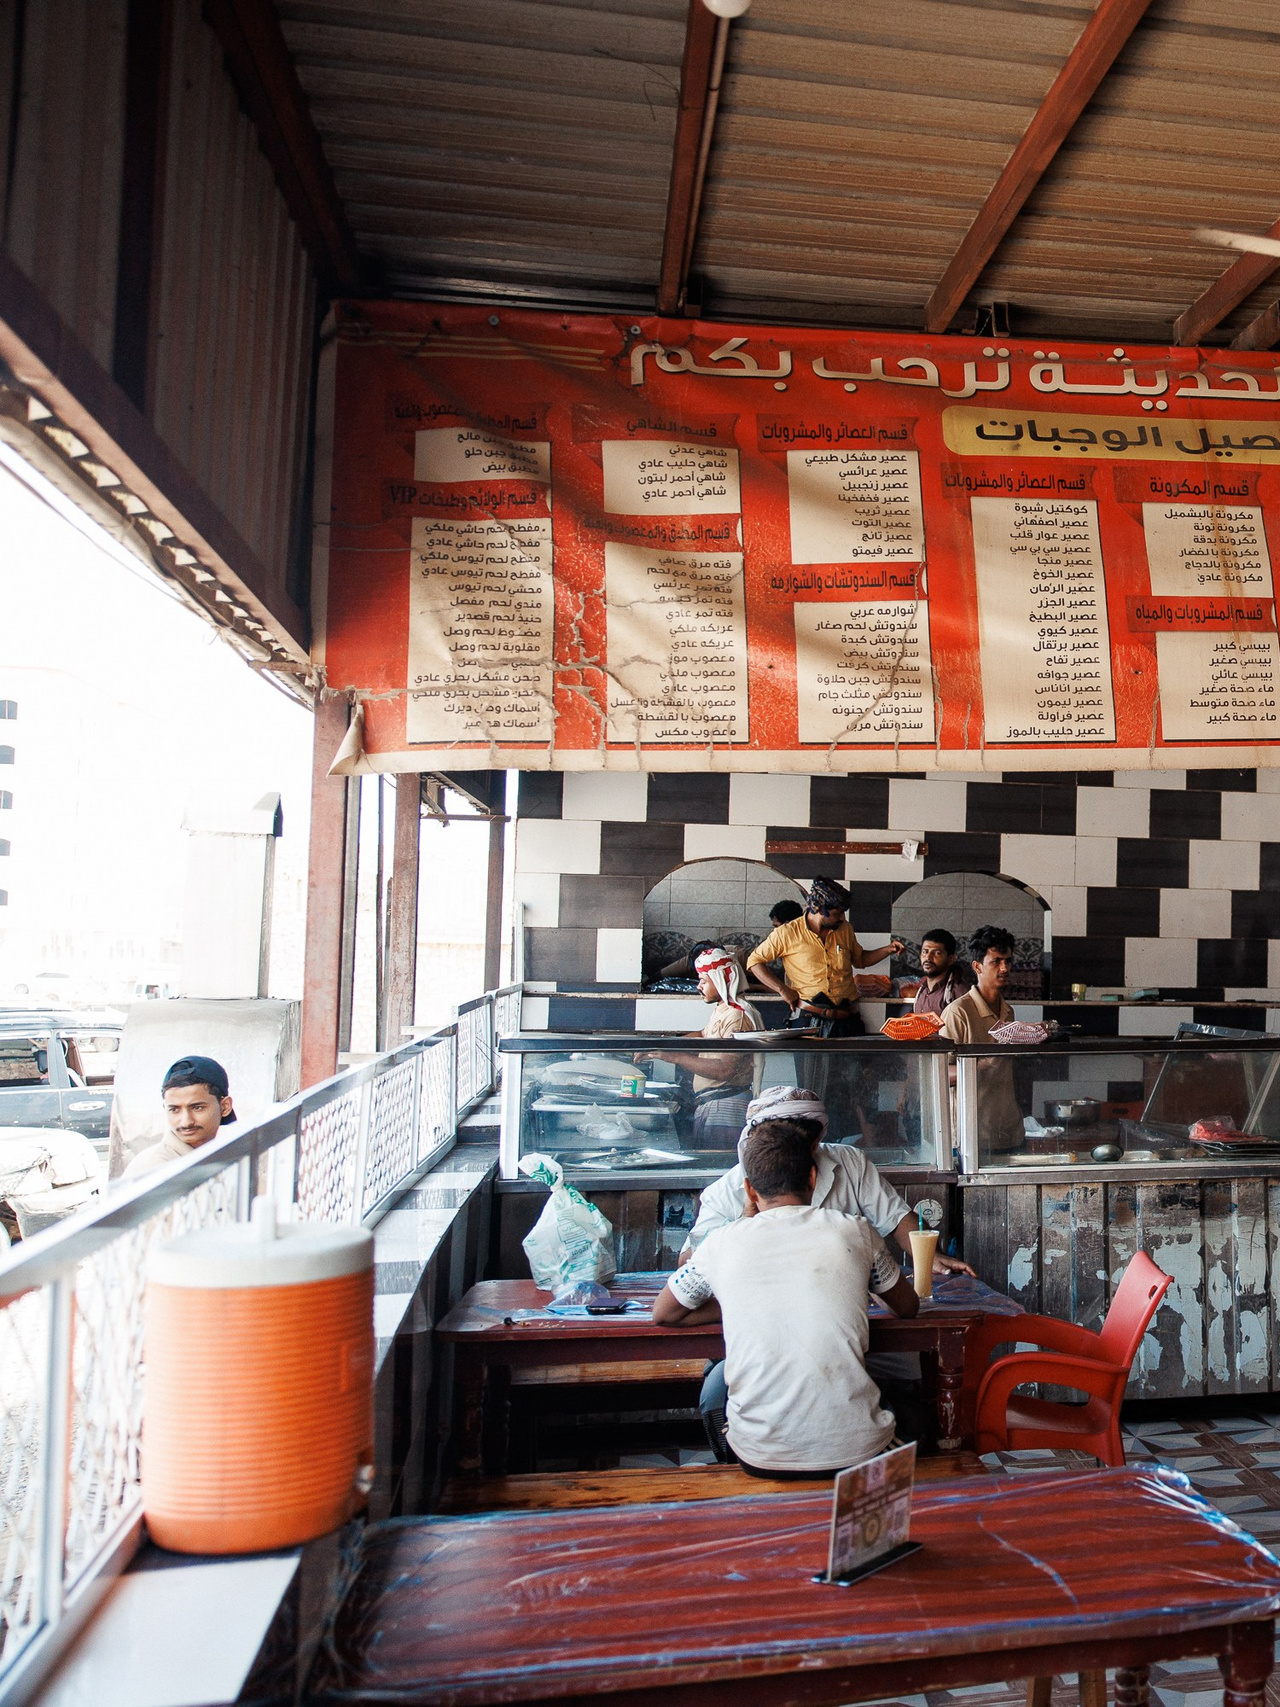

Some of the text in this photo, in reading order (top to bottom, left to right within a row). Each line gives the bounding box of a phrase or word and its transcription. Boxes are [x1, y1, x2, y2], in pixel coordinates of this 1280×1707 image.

[629, 338, 794, 392] بكم
[812, 347, 1011, 398] ترحب
[627, 420, 716, 437] قسم الشاهي
[763, 423, 907, 442] قسم العصائر والمشروبات
[975, 420, 1163, 453] الوجبات
[805, 454, 838, 466] طبيعي
[841, 453, 877, 463] مشكل
[482, 464, 505, 473] بيض
[639, 459, 727, 472] شاهي حليب عادي
[670, 471, 694, 483] أحمر
[697, 472, 725, 485] شاهي
[839, 466, 907, 480] عصير عرائسي
[843, 482, 908, 491] عصير زنجبيل
[945, 472, 1085, 492] قسم العصائر والمشروبات
[1150, 477, 1249, 498] قسم المكرونة
[390, 486, 417, 504] VIP
[839, 495, 909, 504] عصير فخفخينا
[1015, 503, 1087, 515] كوكتيل شبوة
[1165, 508, 1253, 521] مكرونة بالبشميل
[1010, 530, 1033, 538] قلب
[714, 560, 731, 568] فته
[1185, 561, 1261, 570] مكرونة بالدجاج
[422, 567, 447, 578] عادي
[451, 569, 483, 578] تيوس
[771, 569, 915, 593] قسم السندوتشات والشوارمه
[449, 583, 481, 592] تيوس
[508, 586, 541, 595] محشي
[451, 597, 484, 606] مفصل
[850, 607, 914, 617] شوارمه عربي
[1136, 605, 1262, 623] قسم المشروبات والمياه
[815, 620, 917, 632] سندوتش لحم صغار
[449, 642, 475, 652] وصل
[503, 644, 539, 652] مقلوبة
[1033, 640, 1099, 652] عصير برتقال
[1213, 642, 1236, 651] كبير
[1190, 699, 1229, 709] متوسط
[1007, 727, 1104, 738] عصير حليب بالموز
